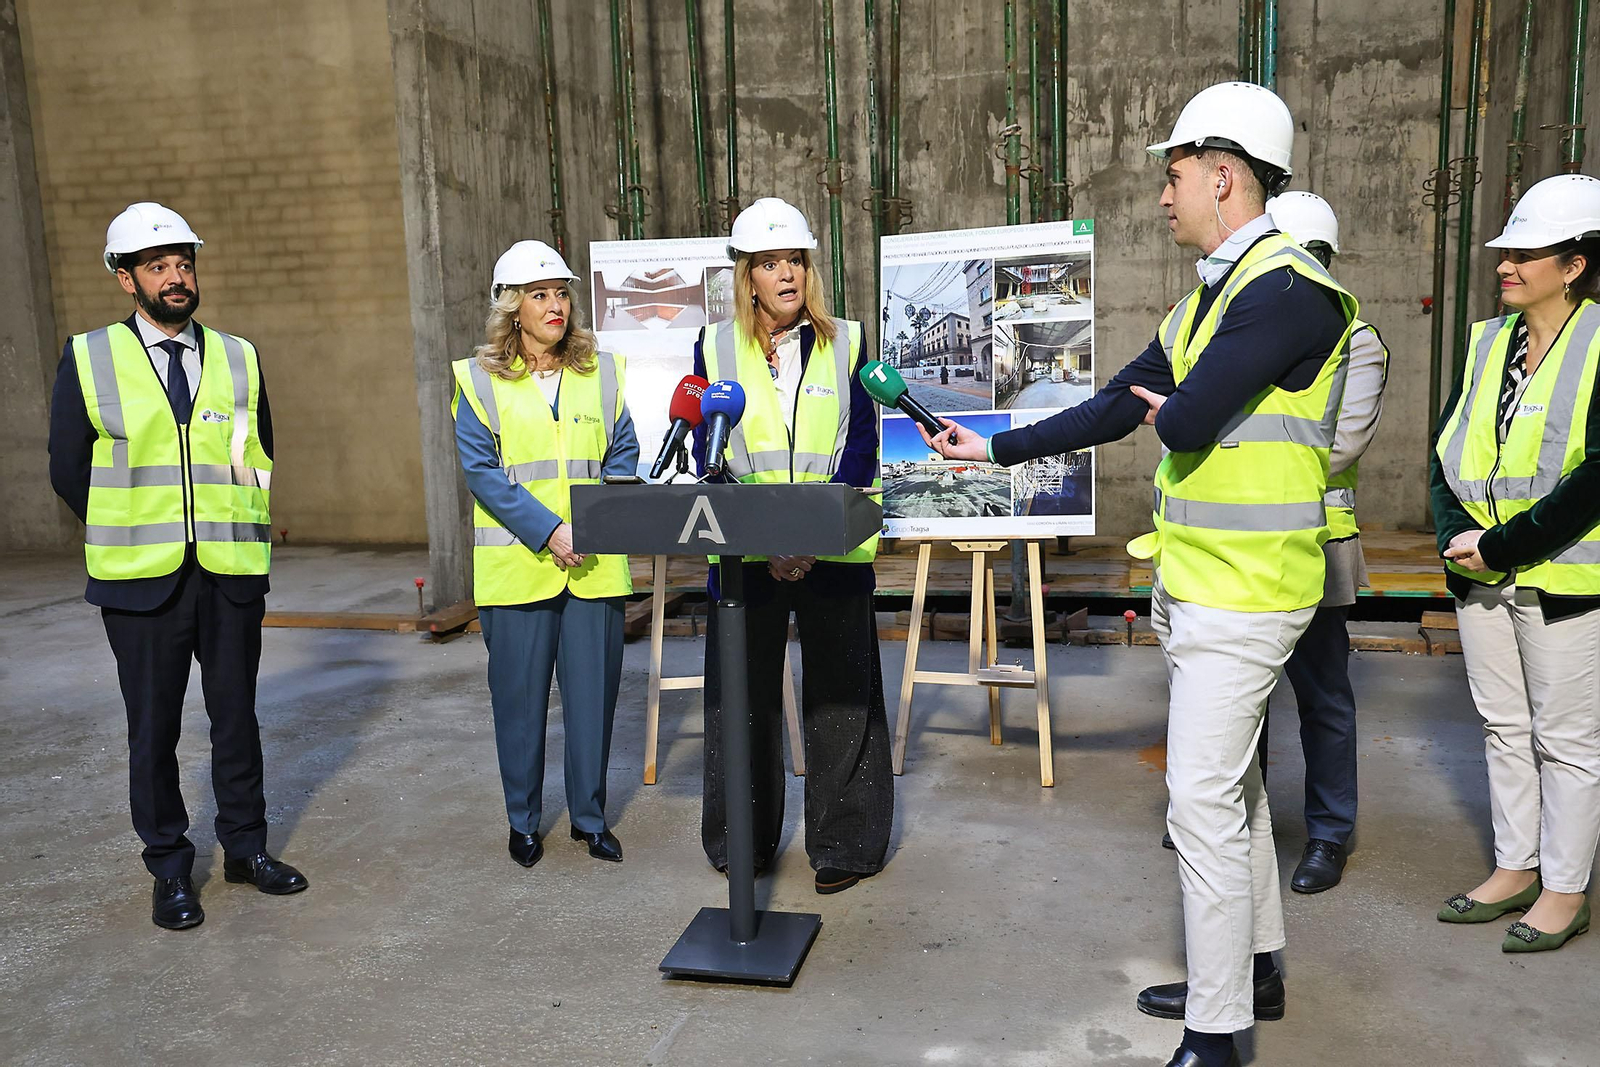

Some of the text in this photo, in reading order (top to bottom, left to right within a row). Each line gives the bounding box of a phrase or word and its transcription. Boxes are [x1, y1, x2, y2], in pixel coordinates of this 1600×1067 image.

[869, 364, 887, 383] T
[684, 382, 706, 394] europ
[686, 390, 704, 400] pres
